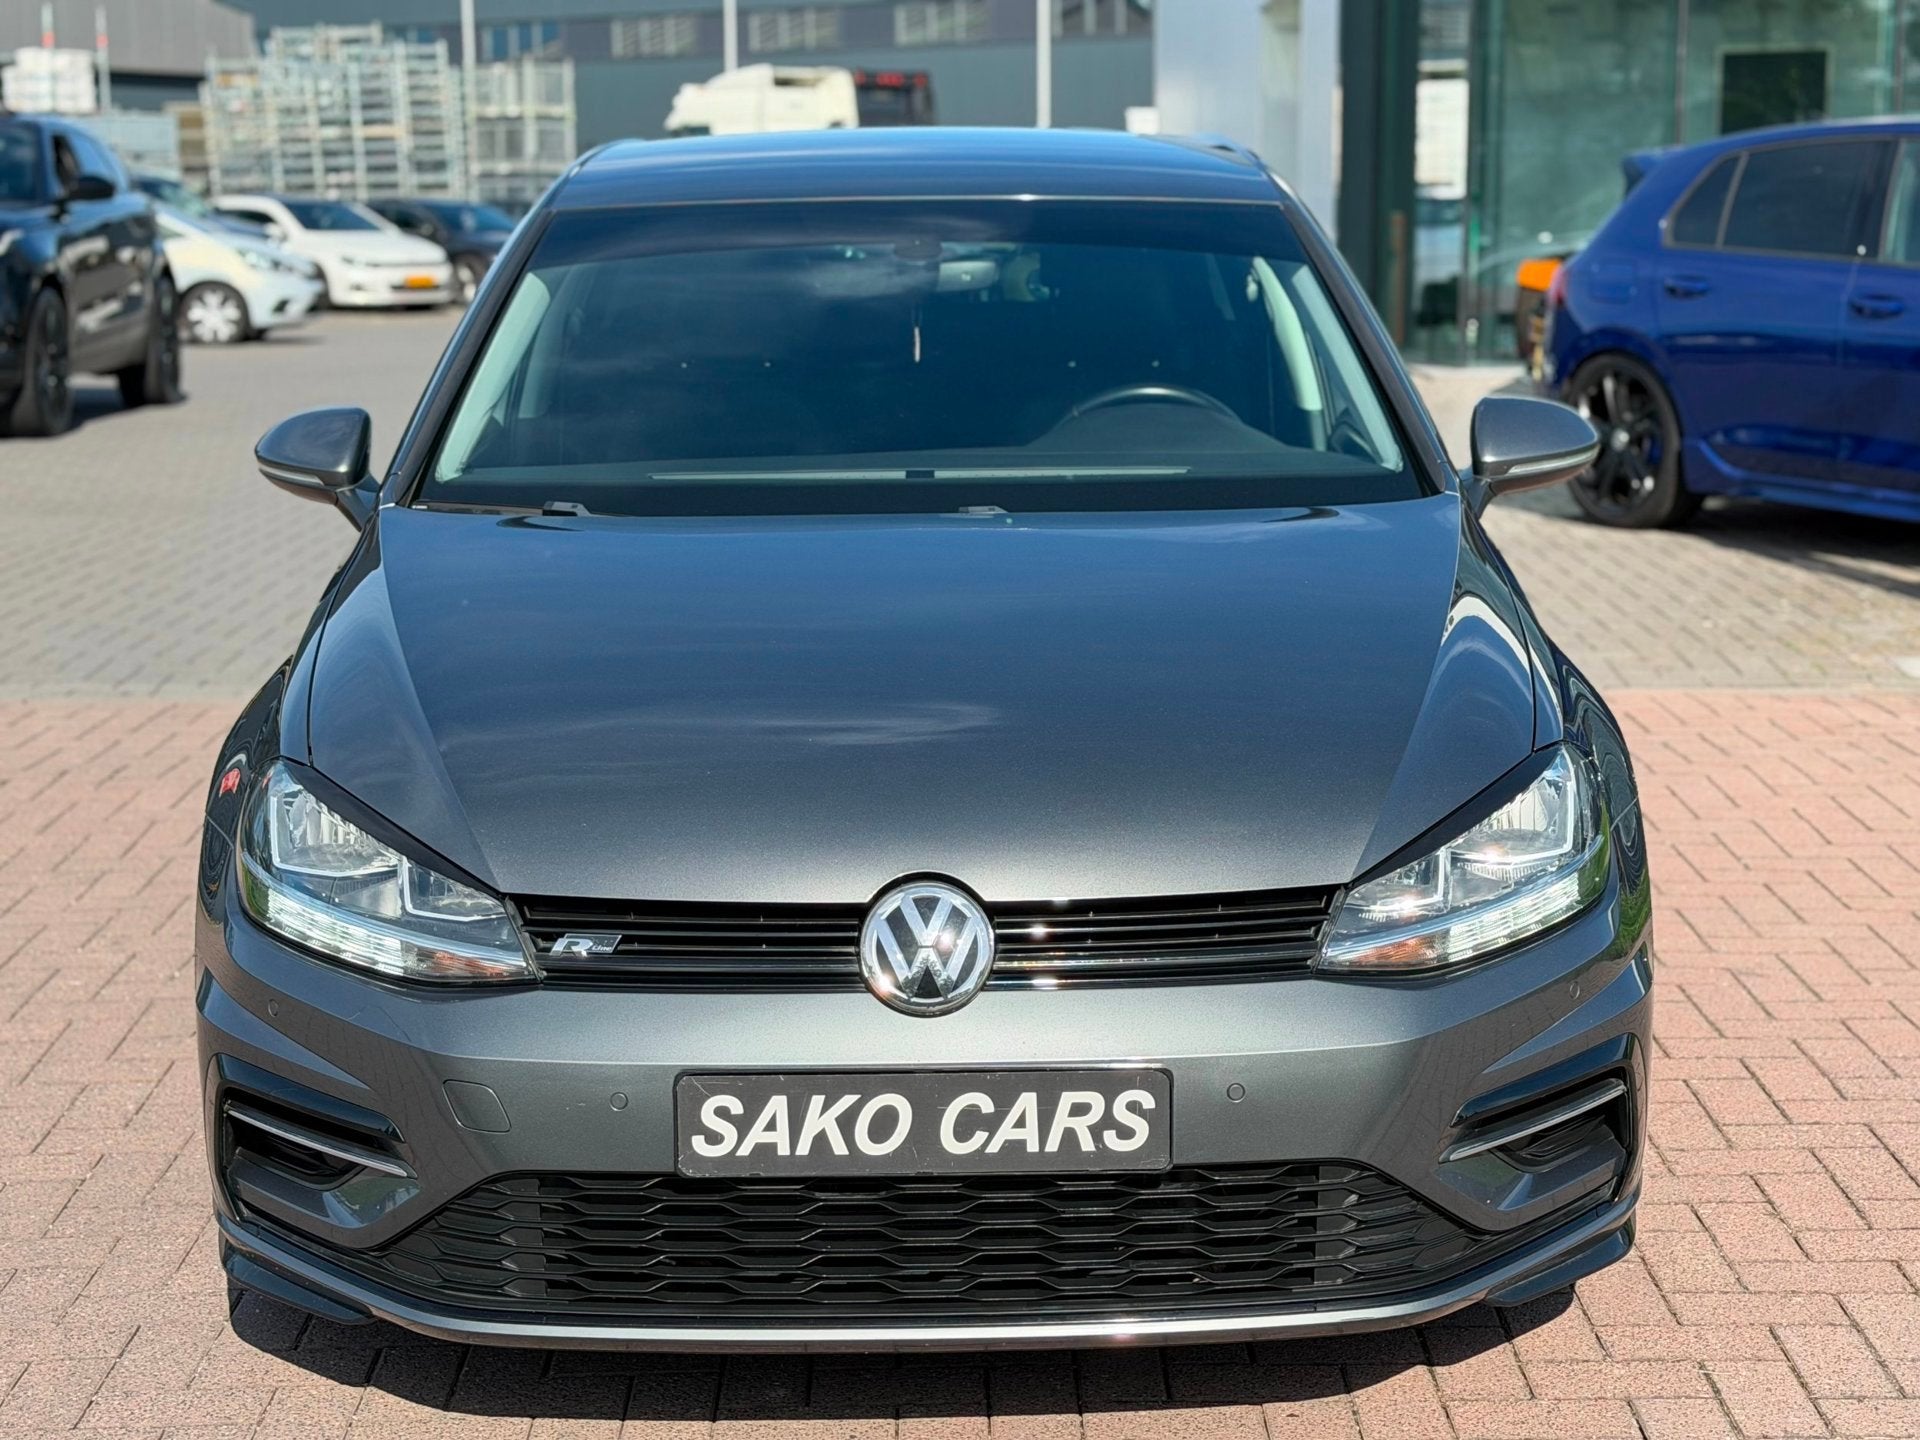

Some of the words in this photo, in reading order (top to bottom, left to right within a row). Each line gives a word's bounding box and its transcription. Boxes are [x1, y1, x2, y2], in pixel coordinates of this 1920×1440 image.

[549, 937, 594, 957] R
[869, 886, 987, 1005] VW
[691, 1092, 913, 1157] SAKO
[939, 1089, 1156, 1154] CARS
